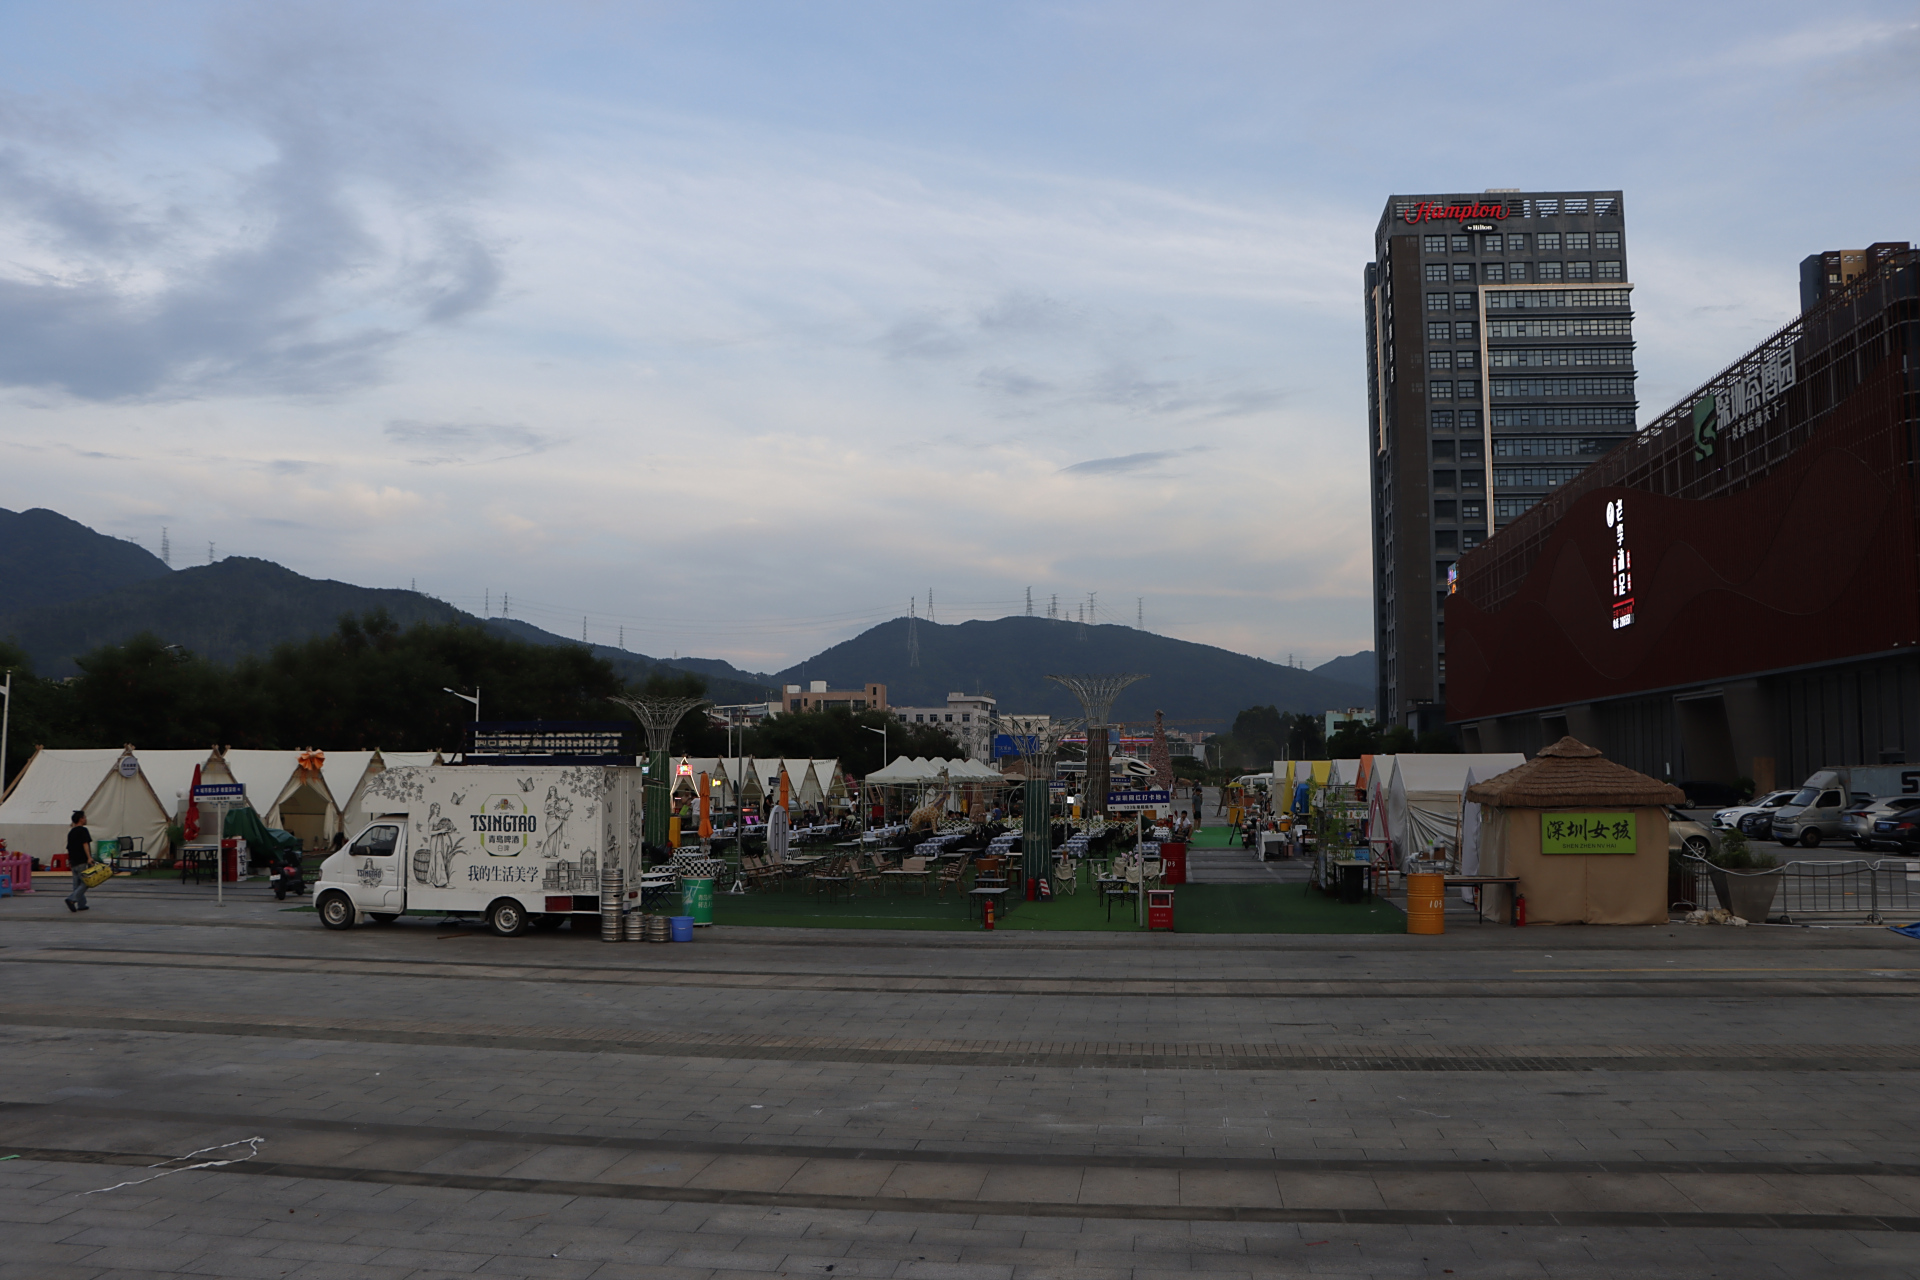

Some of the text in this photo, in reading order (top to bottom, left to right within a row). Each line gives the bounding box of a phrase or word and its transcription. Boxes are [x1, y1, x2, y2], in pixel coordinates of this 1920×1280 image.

[1404, 200, 1510, 224] Hampton
[1715, 344, 1797, 431] 深圳茶博园
[1115, 794, 1162, 802] 深圳网红打卡地
[470, 815, 537, 833] TSINGTAO
[1546, 818, 1632, 841] 深圳女孩
[488, 835, 520, 844] 青岛啤酒
[356, 869, 382, 878] TSINGTAO
[468, 865, 539, 883] 我的生活美学
[1429, 899, 1443, 909] 103
